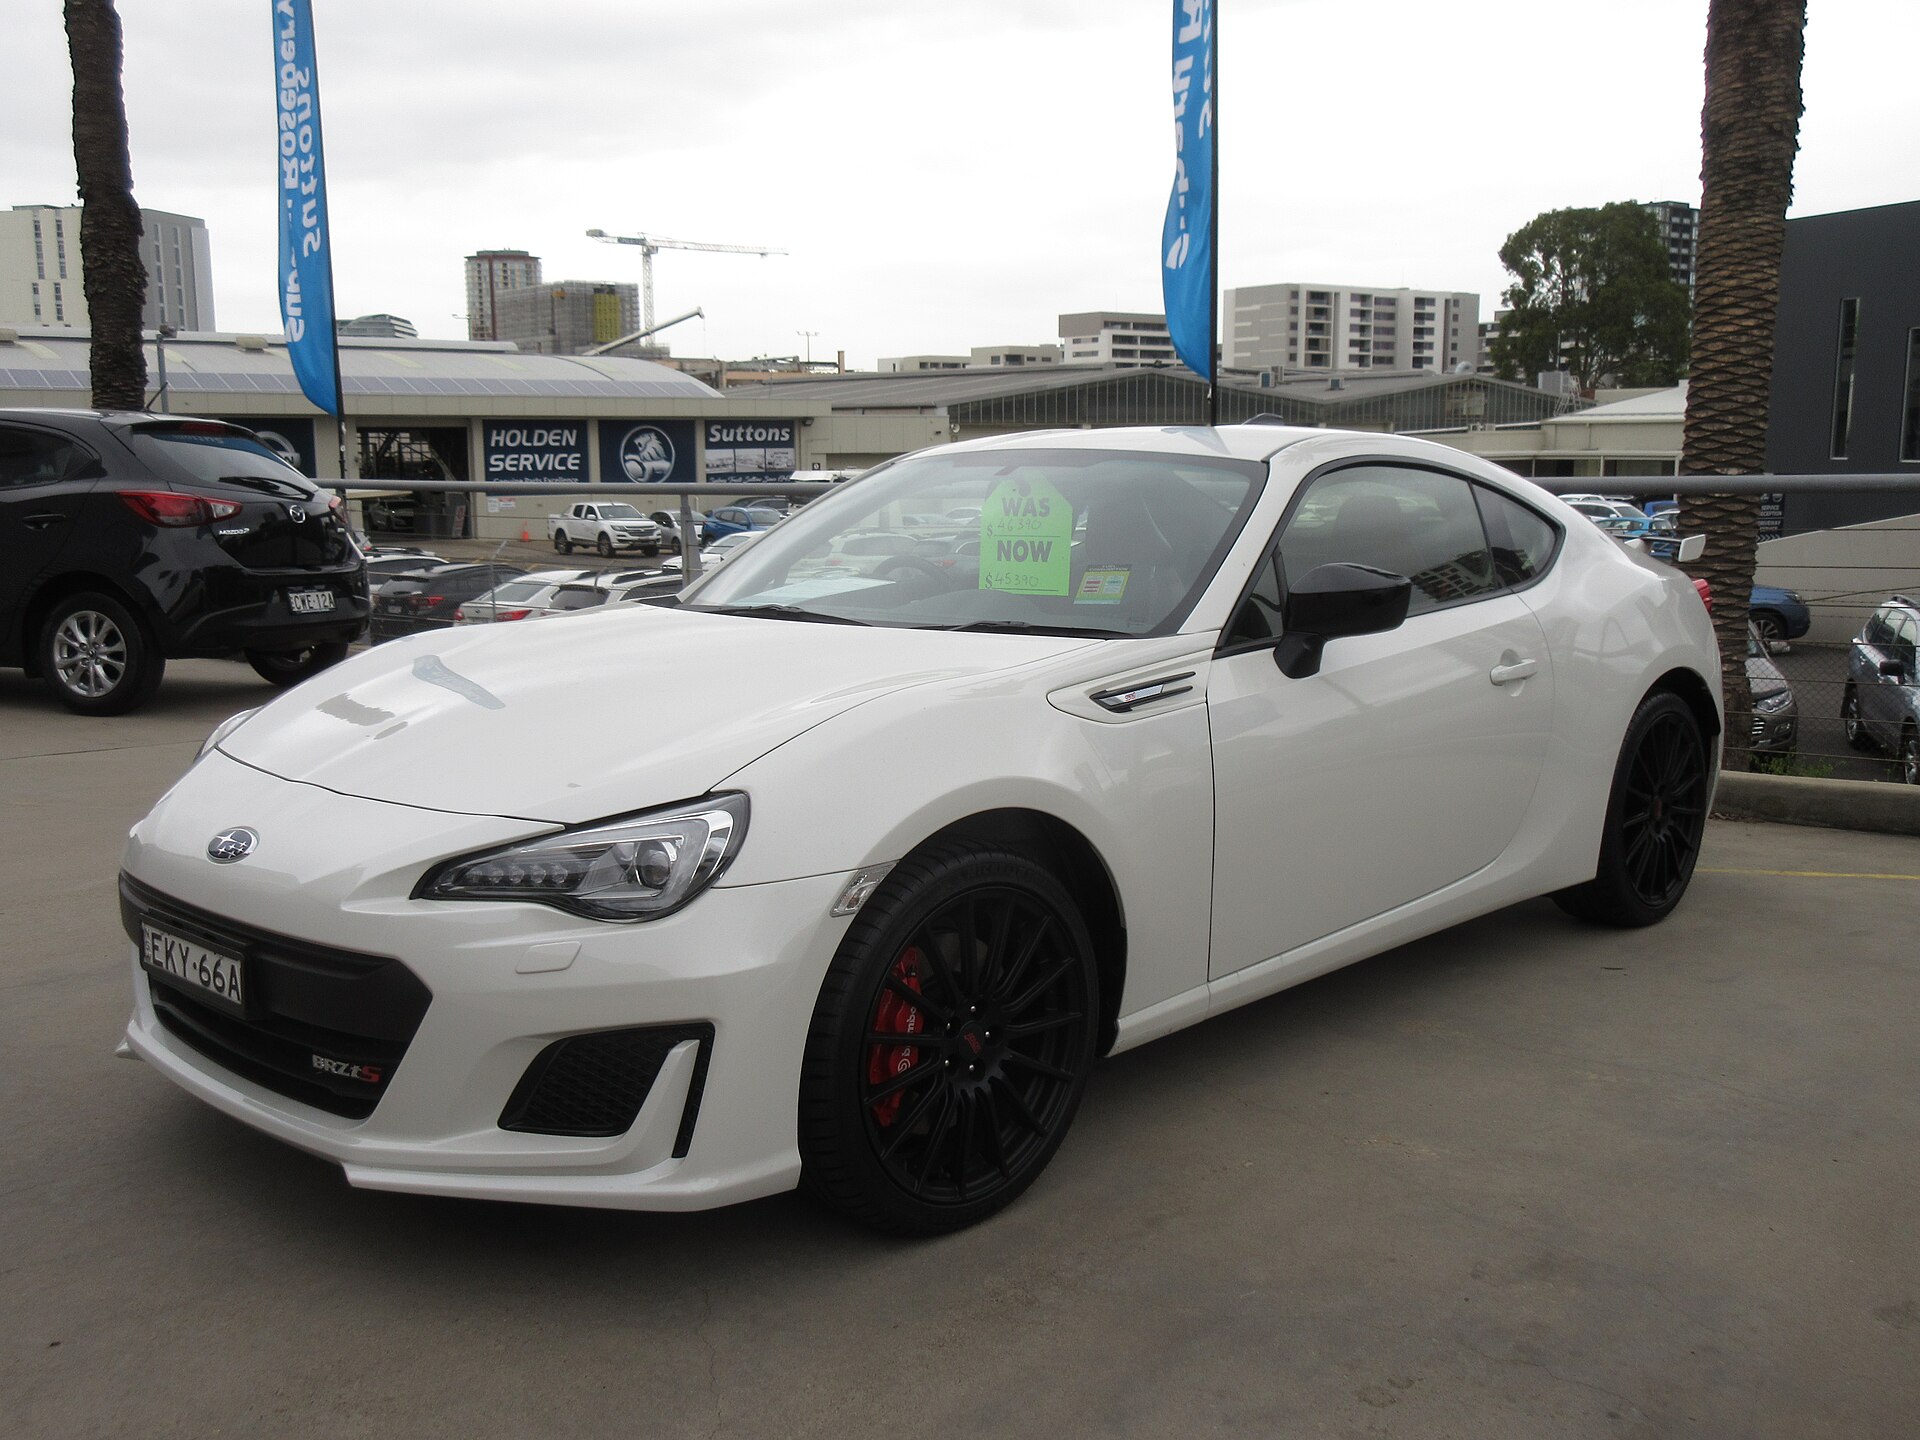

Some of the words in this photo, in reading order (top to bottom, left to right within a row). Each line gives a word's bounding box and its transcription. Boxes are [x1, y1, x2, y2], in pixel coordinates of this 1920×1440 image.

[490, 429, 577, 447] HOLDEN
[709, 424, 790, 442] Suttons
[489, 453, 581, 471] SERVICE
[1002, 497, 1050, 517] WAS
[996, 540, 1053, 563] NOW
